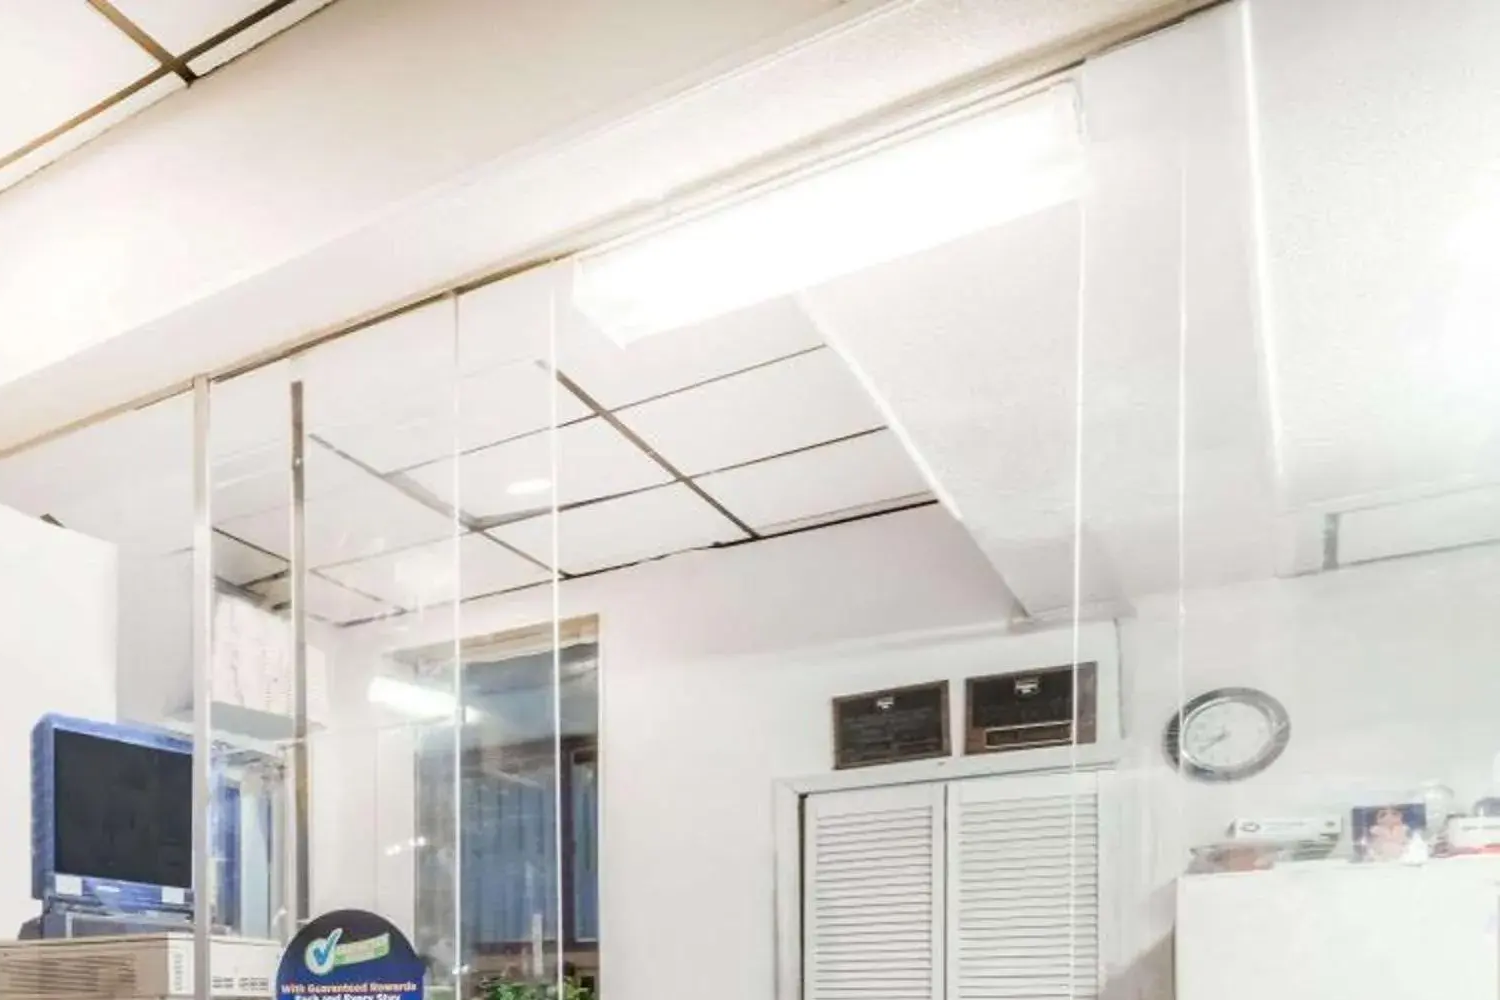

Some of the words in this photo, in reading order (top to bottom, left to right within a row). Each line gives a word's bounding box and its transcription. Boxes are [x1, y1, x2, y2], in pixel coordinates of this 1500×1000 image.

[281, 984, 304, 993] With
[307, 983, 367, 993] Guaranteed
[370, 982, 416, 992] Rewards
